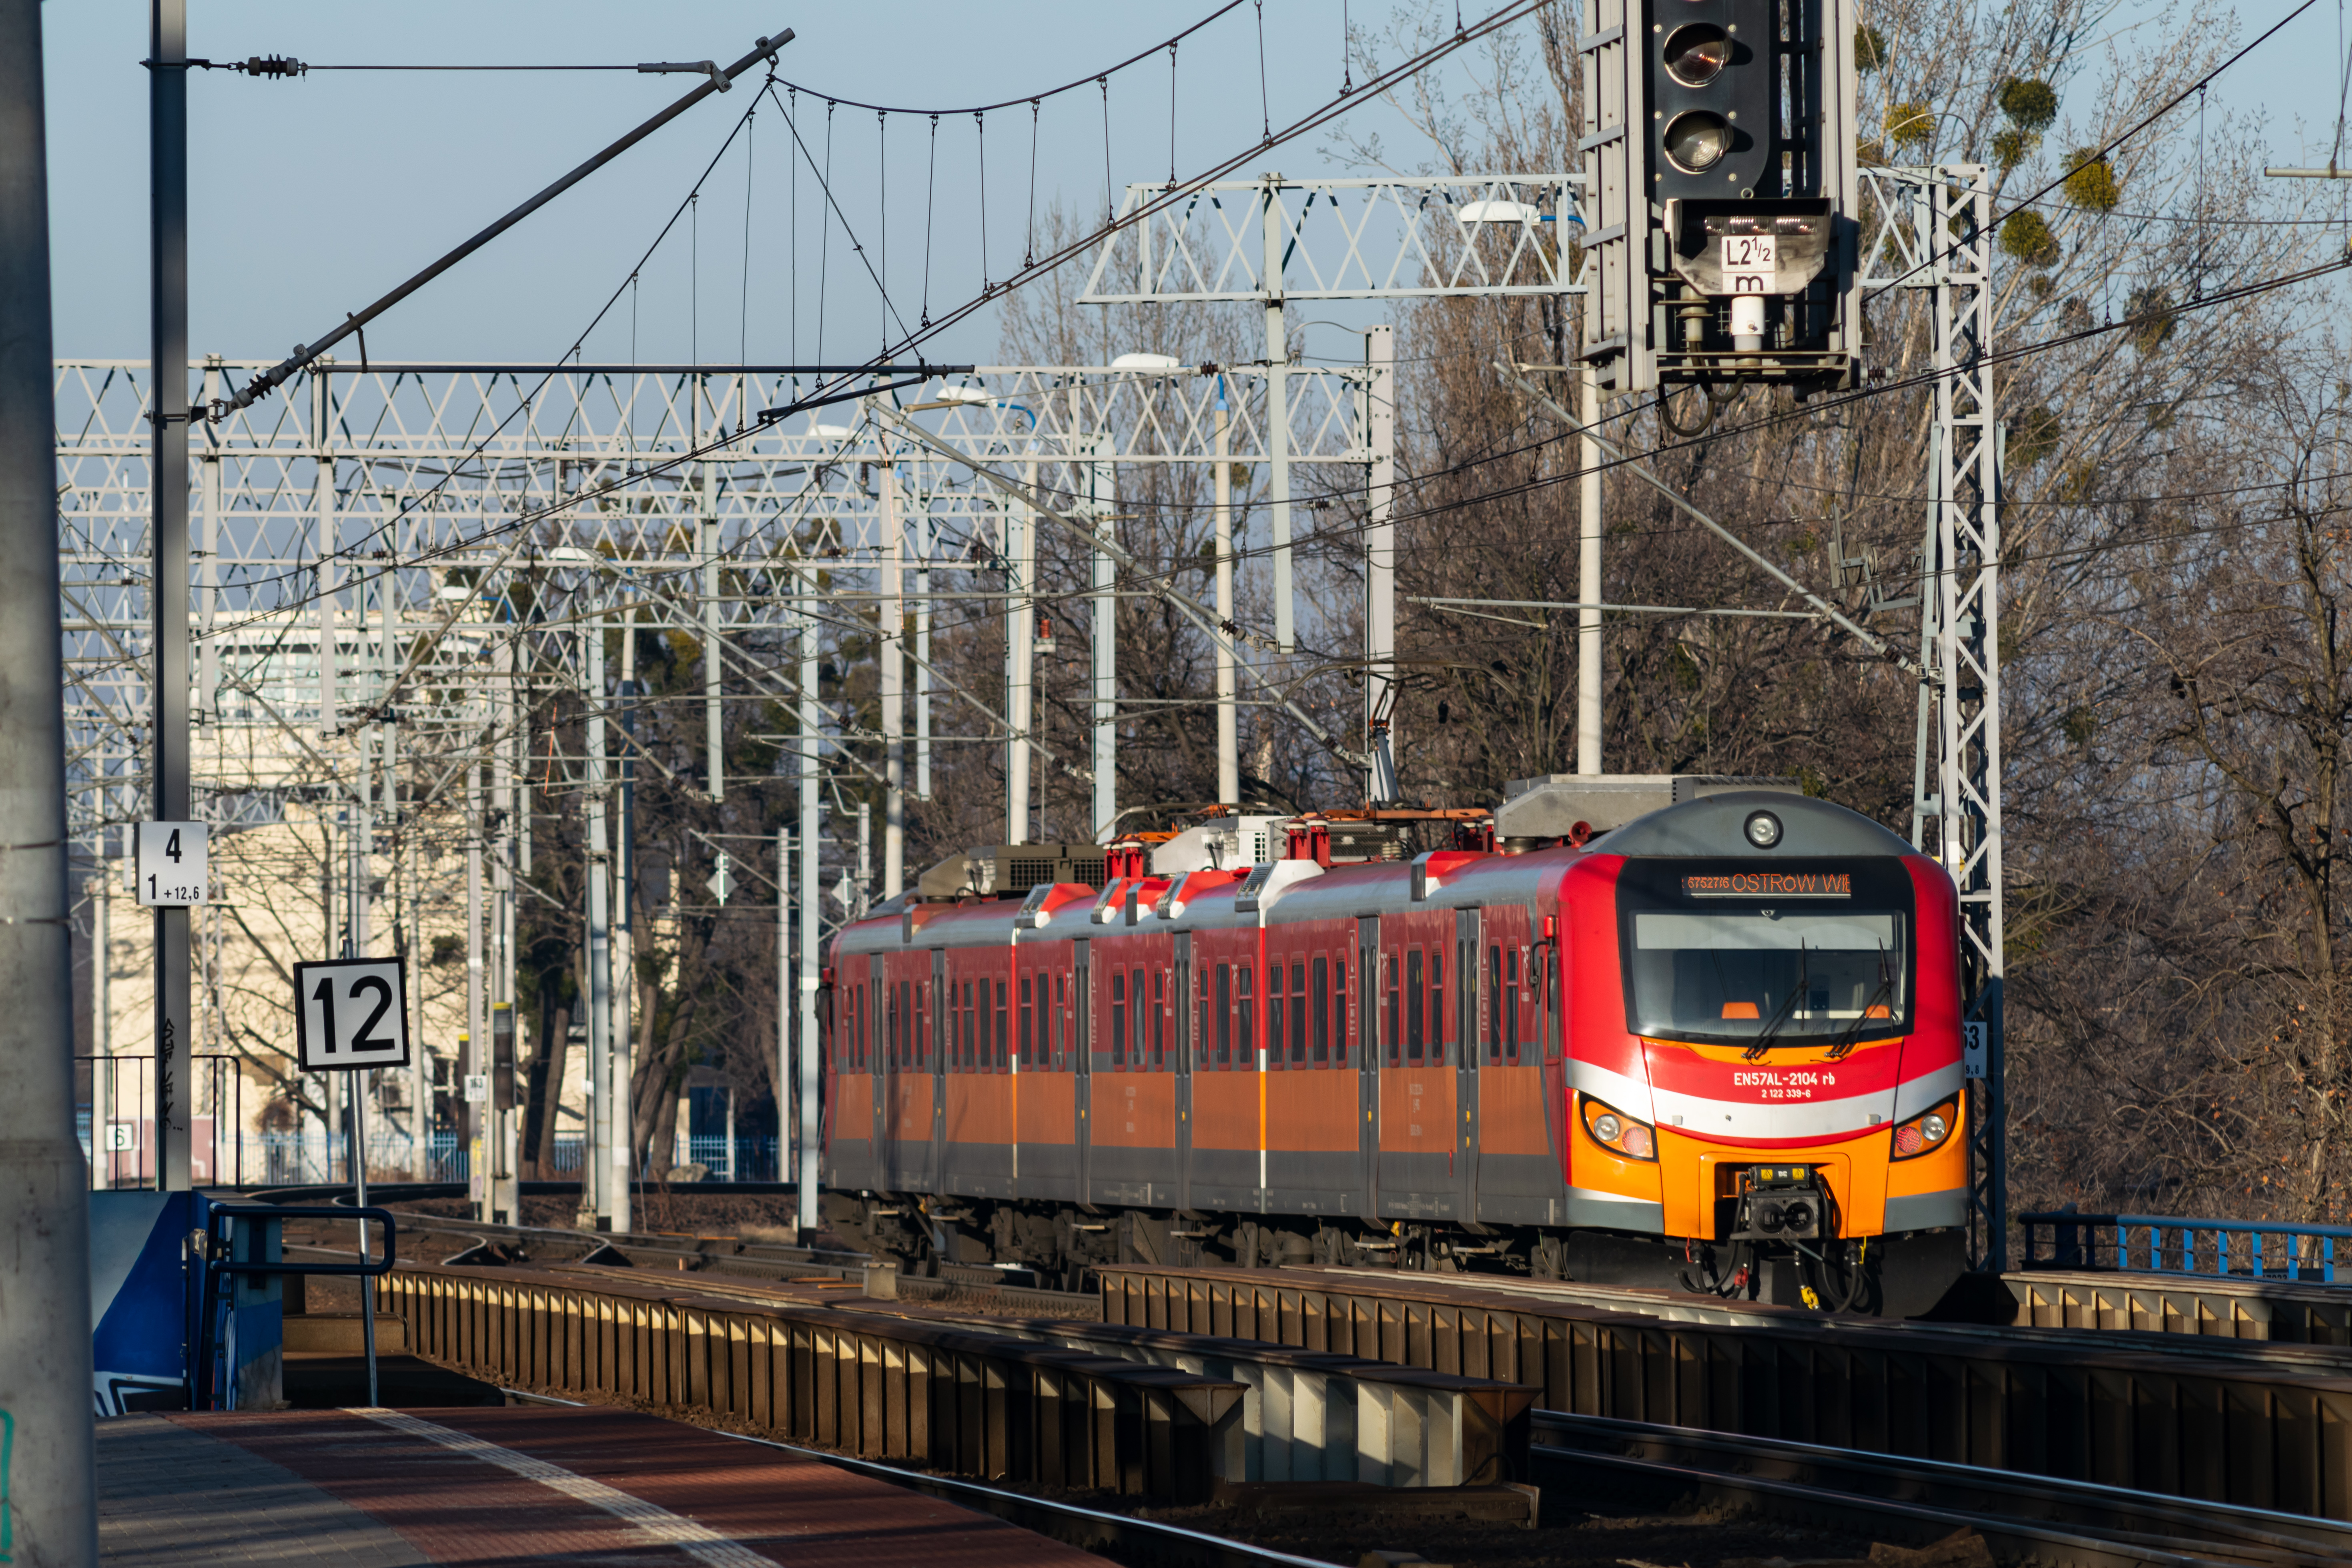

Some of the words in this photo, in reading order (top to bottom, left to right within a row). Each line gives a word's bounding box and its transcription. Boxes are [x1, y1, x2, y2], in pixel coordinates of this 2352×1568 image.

[1736, 276, 1764, 292] m
[166, 828, 182, 863] 4
[148, 874, 156, 899] 1
[1732, 874, 1815, 892] OSTRÓW
[312, 975, 395, 1053] 12
[1734, 1073, 1818, 1085] EN57AL-2104
[1823, 1072, 1835, 1085] rb
[1762, 1089, 1767, 1098] 2
[1770, 1089, 1783, 1098] 122
[1786, 1089, 1811, 1098] 339-6
[116, 1128, 124, 1146] 6
